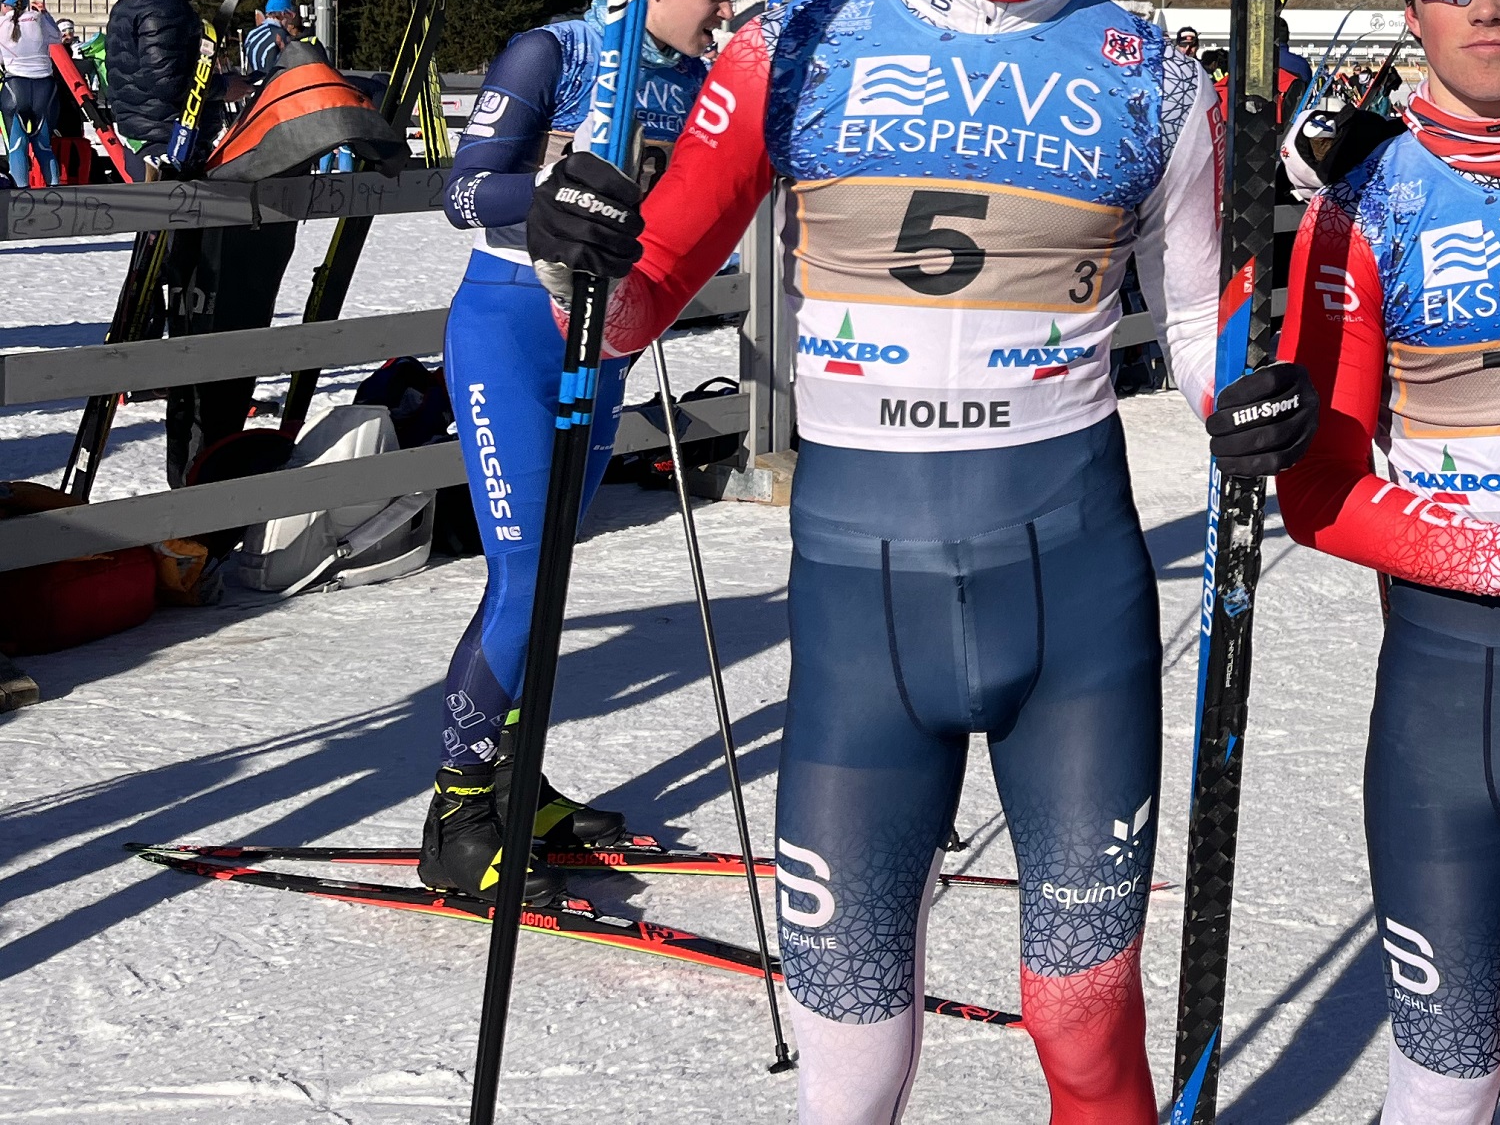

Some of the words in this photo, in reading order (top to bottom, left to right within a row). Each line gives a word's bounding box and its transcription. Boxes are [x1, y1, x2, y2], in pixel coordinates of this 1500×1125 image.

[951, 56, 1102, 136] VVS
[838, 119, 1101, 178] EKSPERTEN
[888, 190, 990, 296] 5
[1068, 260, 1098, 304] 3
[797, 335, 910, 365] MAXBO
[879, 397, 1011, 429] MOLDE
[1202, 466, 1222, 638] salomon
[547, 851, 628, 866] ROSSIGNOL
[1042, 874, 1142, 909] equinor
[488, 906, 561, 931] RIGNOL
